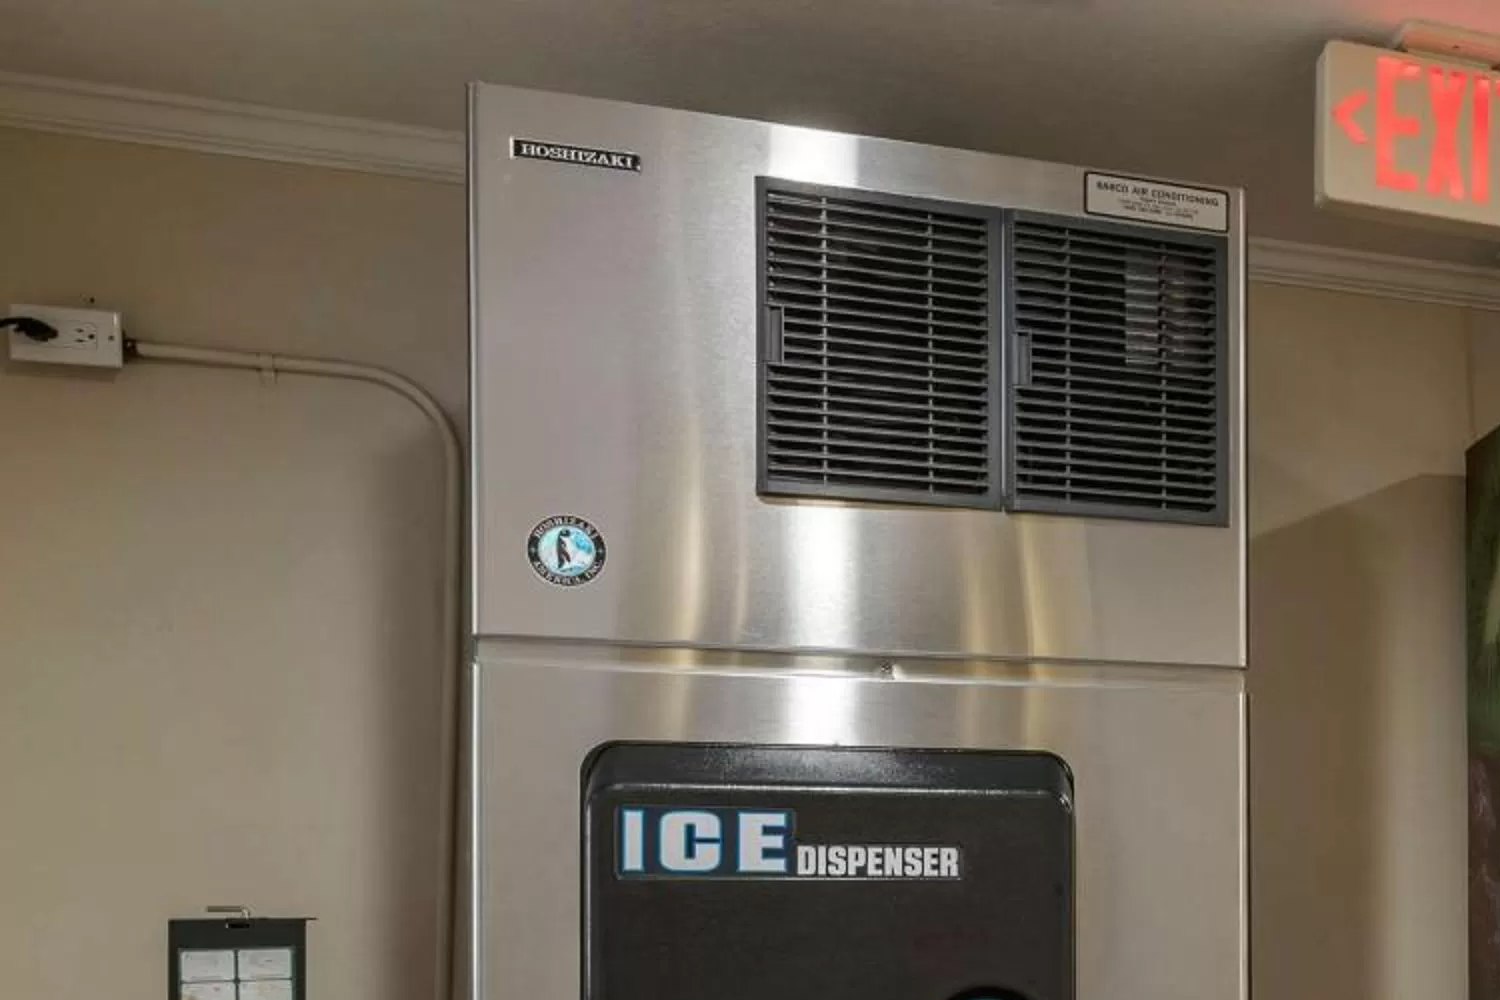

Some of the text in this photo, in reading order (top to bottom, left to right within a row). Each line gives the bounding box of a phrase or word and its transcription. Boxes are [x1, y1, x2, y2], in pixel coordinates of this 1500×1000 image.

[521, 143, 634, 169] HOSHIZAKI
[1151, 189, 1219, 207] CONDITIONING
[622, 809, 959, 877] ICE DISPENSER
